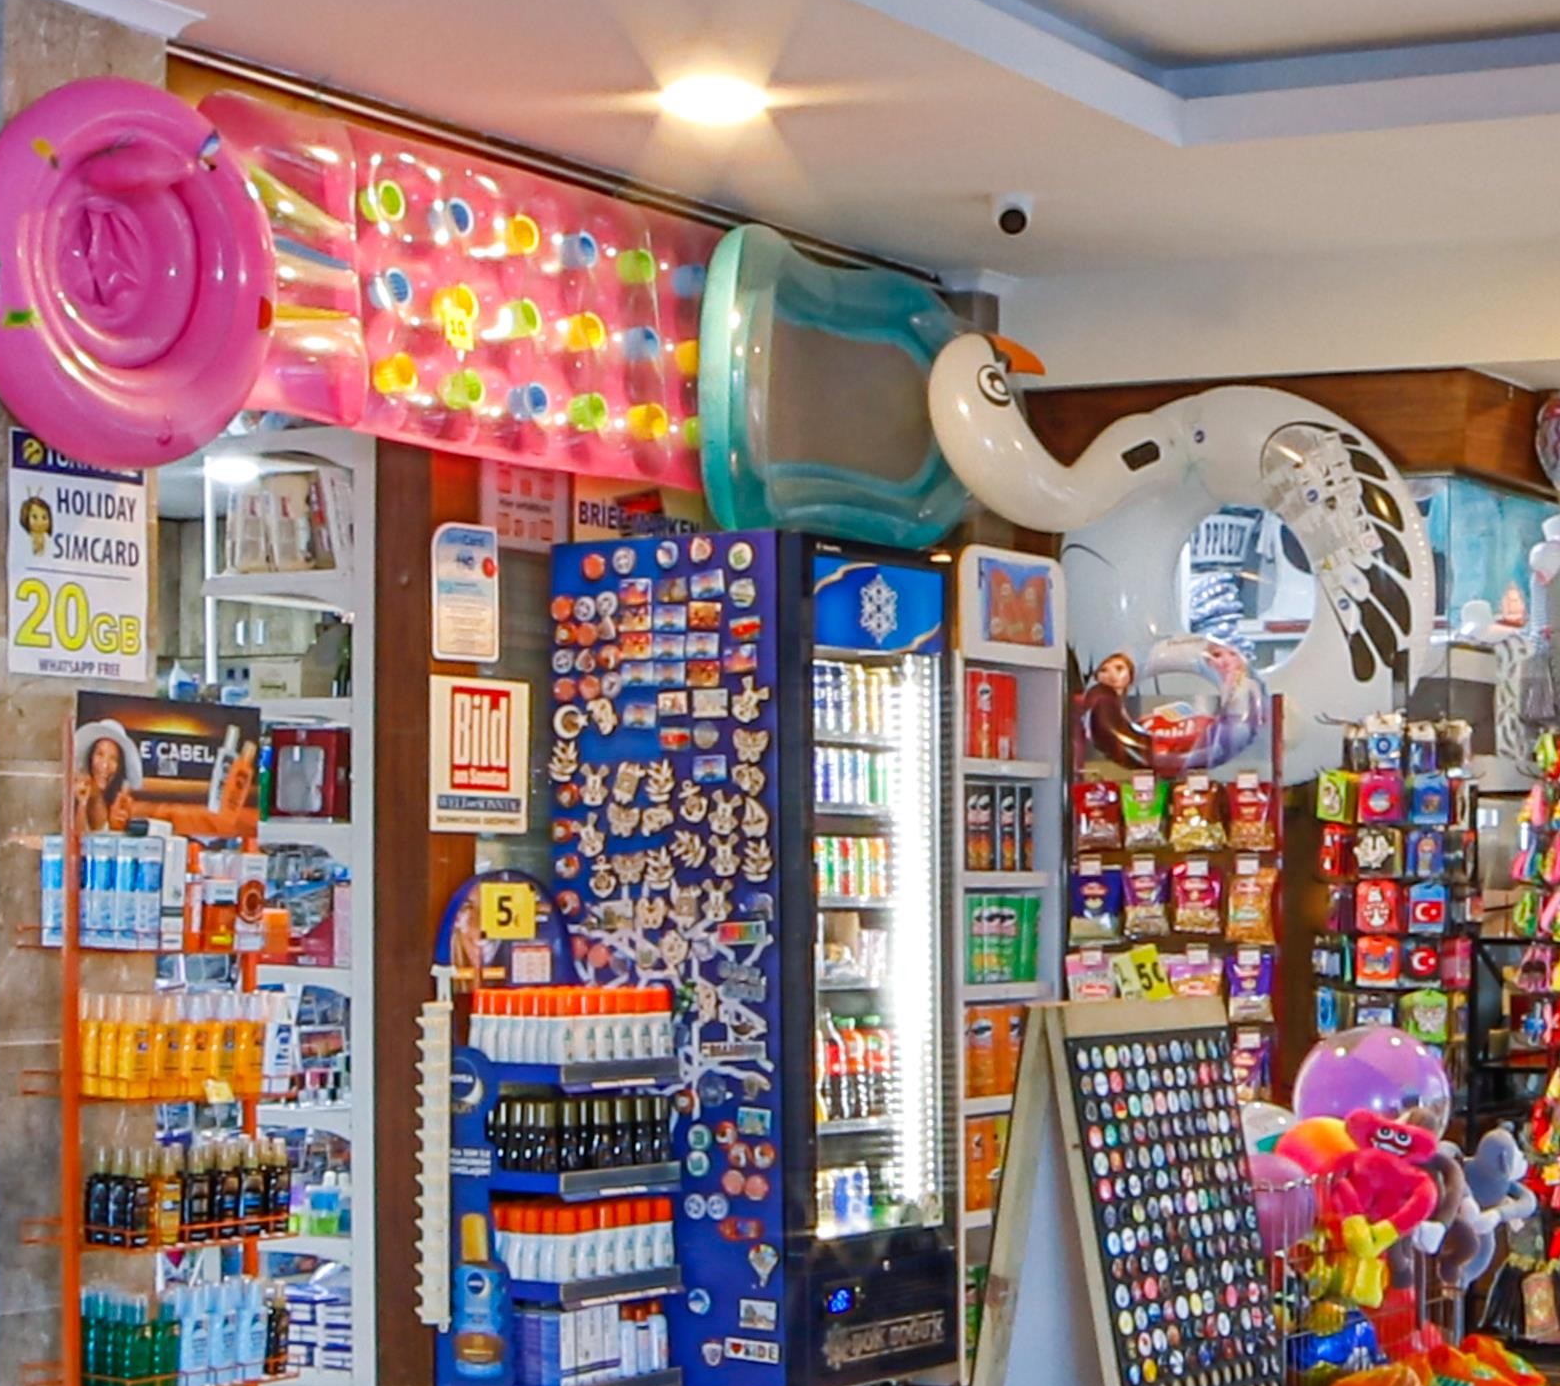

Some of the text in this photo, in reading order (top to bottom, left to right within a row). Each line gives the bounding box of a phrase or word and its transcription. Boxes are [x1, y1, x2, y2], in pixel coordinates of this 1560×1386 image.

[56, 487, 137, 523] HOLIDAY
[53, 532, 140, 567] SIMCARD
[14, 577, 141, 655] 20GB
[38, 658, 121, 677] WHATSAPP FREE
[454, 692, 508, 768] Bild
[156, 742, 215, 763] CABEL
